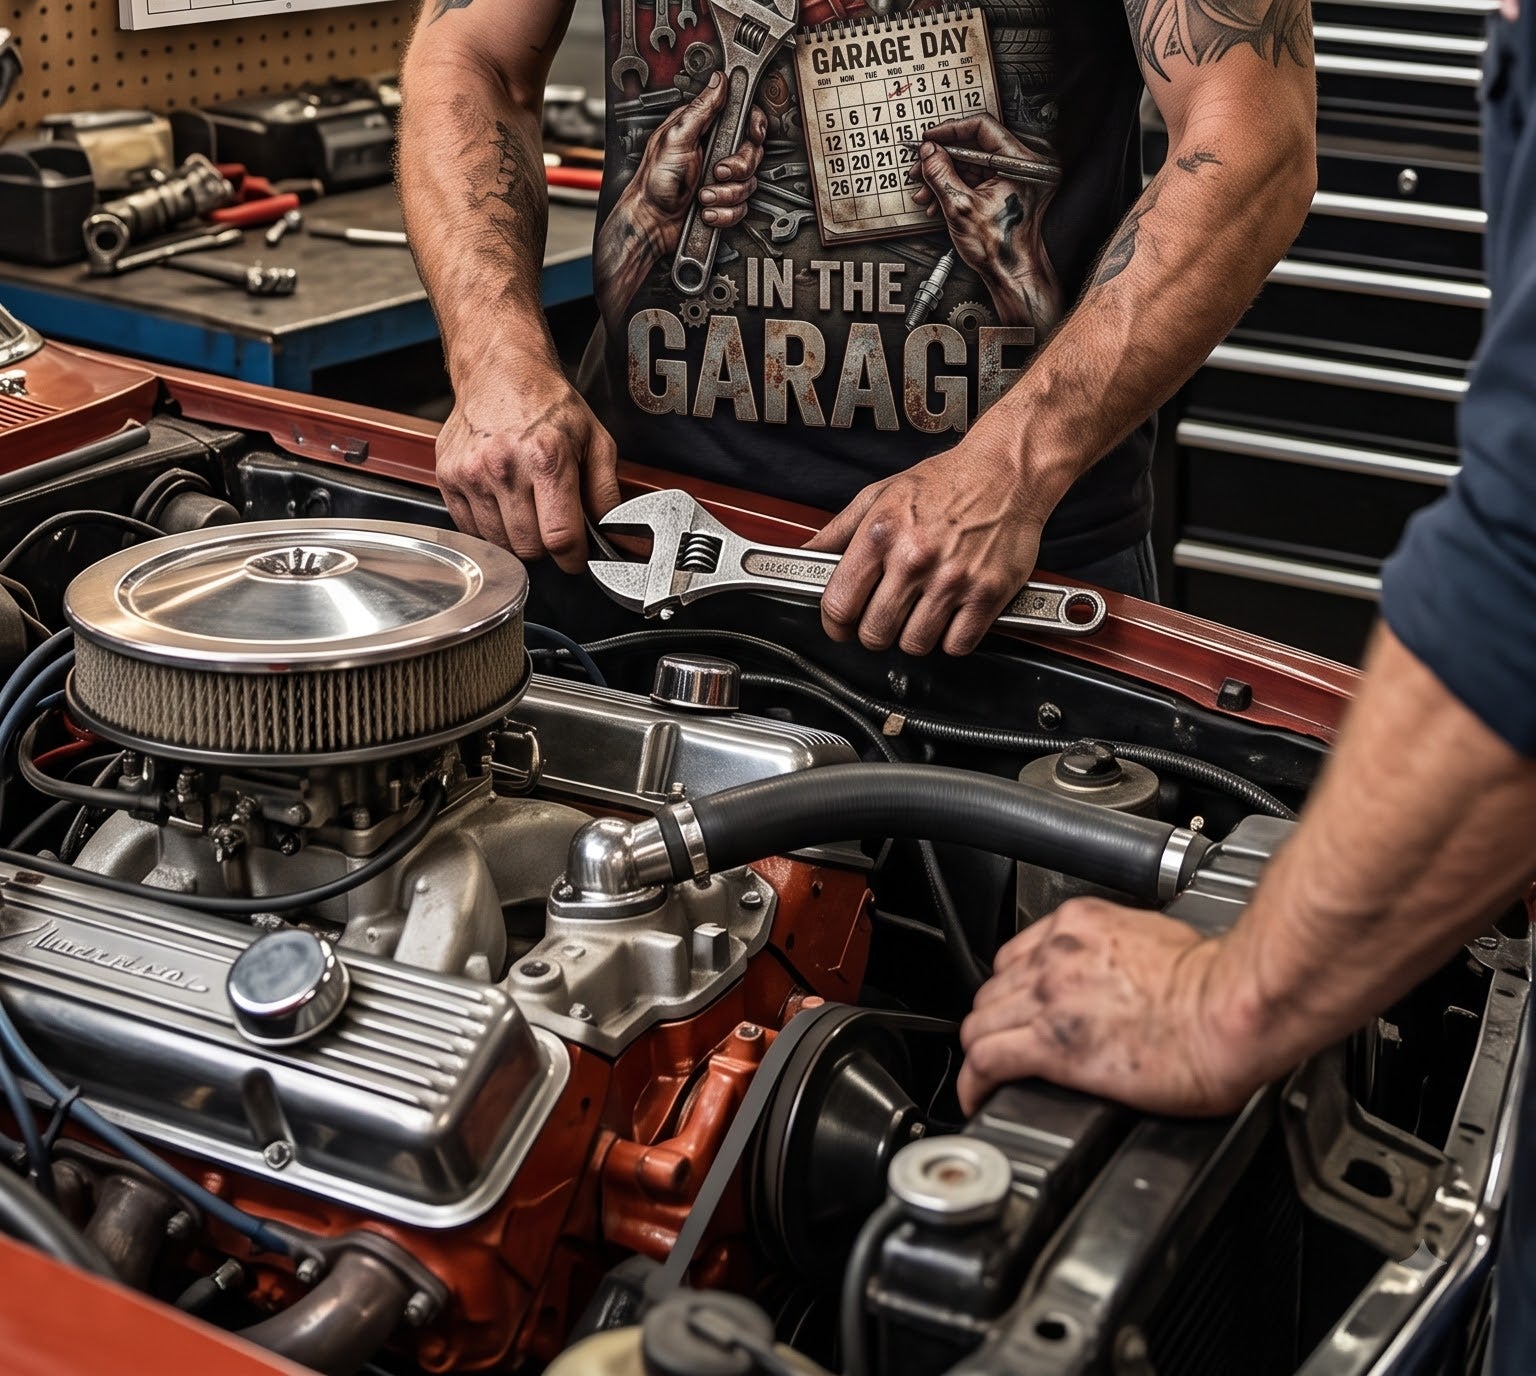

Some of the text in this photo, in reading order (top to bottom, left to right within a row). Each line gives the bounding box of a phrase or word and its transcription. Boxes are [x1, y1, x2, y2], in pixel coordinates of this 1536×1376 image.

[811, 26, 969, 75] GARAGE DAY
[916, 77, 927, 93] 3
[940, 73, 951, 89] 4
[964, 69, 974, 85] 5
[825, 91, 982, 129] 5 6 7 8 10 11 12
[825, 135, 843, 152] 12
[848, 131, 866, 149] 13
[872, 128, 890, 145] 14
[895, 124, 914, 142] 15
[828, 157, 846, 174] 19
[851, 153, 871, 171] 20
[875, 151, 893, 168] 21
[830, 179, 850, 197] 26
[855, 176, 873, 194] 27
[878, 172, 898, 190] 28
[746, 257, 906, 313] IN THE
[627, 308, 1036, 434] GARAGE
